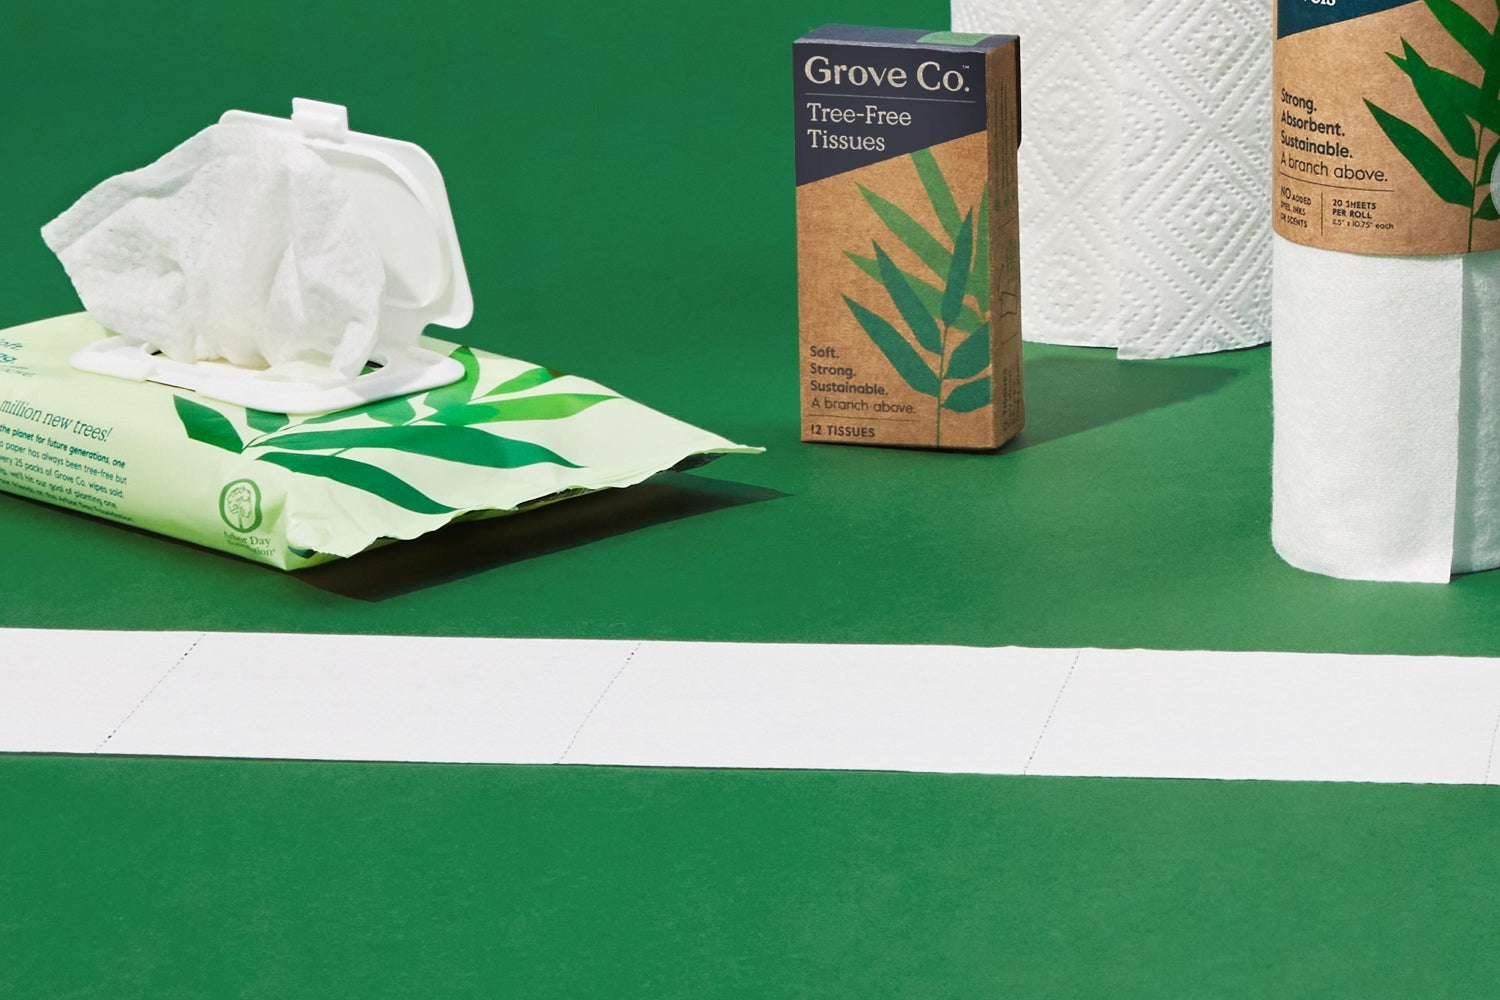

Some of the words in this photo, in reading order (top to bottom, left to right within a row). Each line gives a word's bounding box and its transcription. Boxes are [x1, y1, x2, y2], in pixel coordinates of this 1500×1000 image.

[804, 56, 907, 88] Grove
[1281, 88, 1317, 114] Strong.
[806, 103, 912, 126] Tree-Free
[1281, 110, 1345, 136] Absorbent.
[806, 129, 886, 152] Tissues
[1280, 130, 1353, 158] Sustainable.
[1280, 152, 1287, 165] A
[1288, 153, 1328, 176] branch
[1333, 164, 1388, 182] above.
[1332, 208, 1346, 217] PER
[1349, 210, 1372, 220] ROLL
[1333, 199, 1342, 207] 20
[1345, 200, 1377, 210] SHEETS
[1375, 222, 1394, 230] each
[810, 345, 839, 359] Soft.
[810, 363, 857, 379] Strong.
[810, 380, 889, 396] Sustainable.
[811, 397, 820, 408] A
[824, 396, 868, 411] branch
[873, 401, 916, 414] above.
[0, 400, 42, 422] million
[42, 413, 73, 430] new
[73, 420, 114, 442] trees!
[810, 424, 822, 435] 12
[827, 425, 876, 438] TISSUES
[12, 428, 34, 439] planet
[35, 433, 45, 444] for
[47, 437, 68, 451] future
[112, 459, 126, 469] one
[5, 442, 26, 453] paper
[28, 447, 40, 458] has
[41, 452, 64, 466] always
[65, 458, 82, 470] been
[84, 465, 114, 480] tree-free
[115, 473, 127, 485] but
[25, 462, 44, 474] packs
[54, 470, 74, 483] Grove
[249, 536, 271, 547] Day
